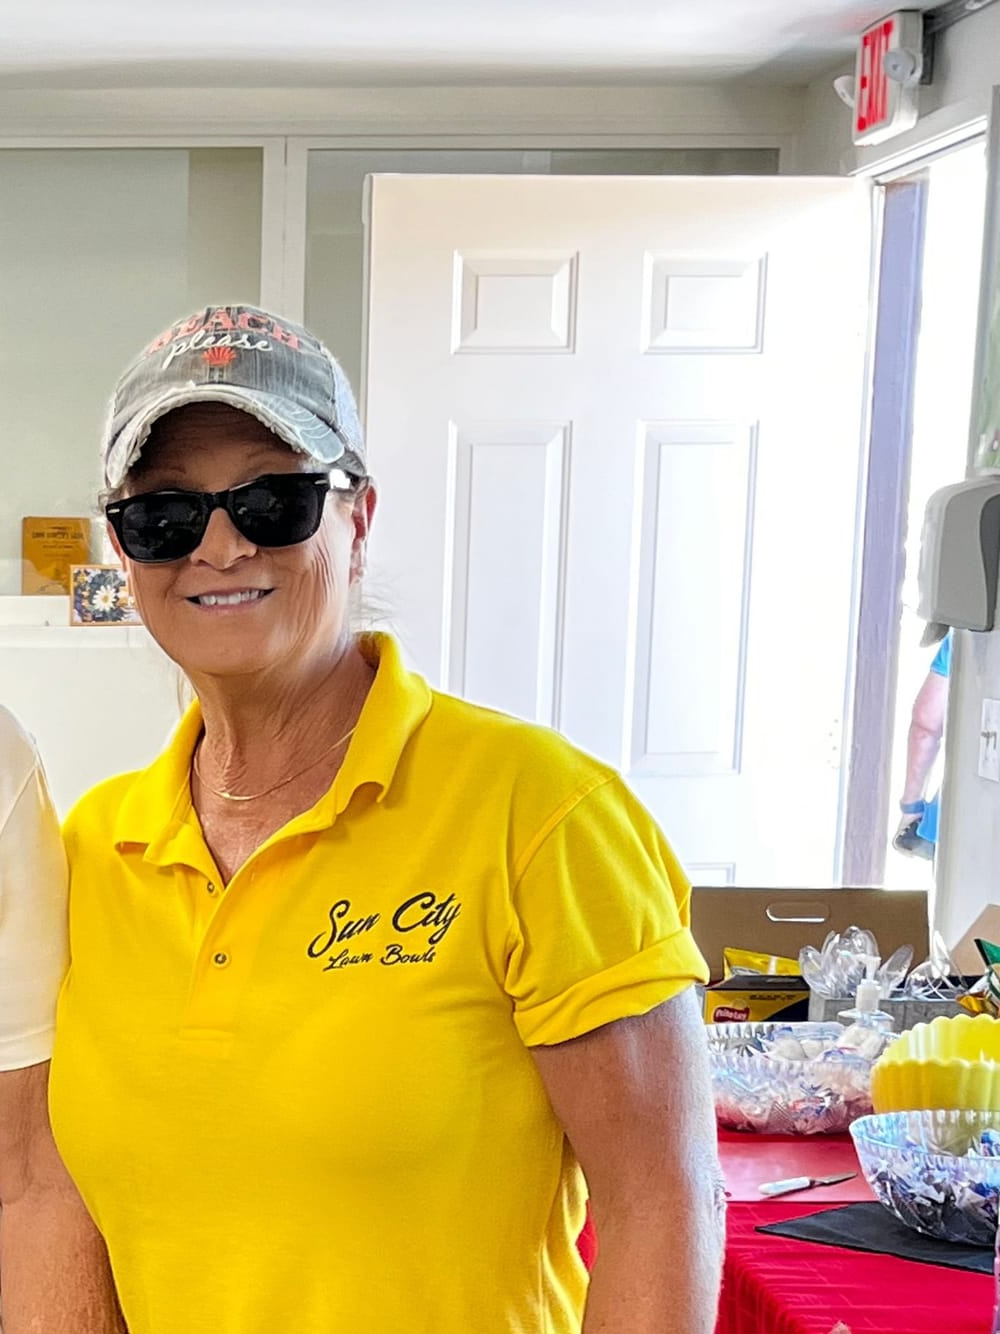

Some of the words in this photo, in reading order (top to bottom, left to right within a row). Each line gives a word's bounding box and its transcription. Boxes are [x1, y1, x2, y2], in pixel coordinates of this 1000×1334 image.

[162, 329, 273, 370] please
[307, 899, 380, 958] Sun
[391, 891, 462, 945] City
[322, 948, 374, 972] Lawn
[379, 943, 437, 966] Bowls
